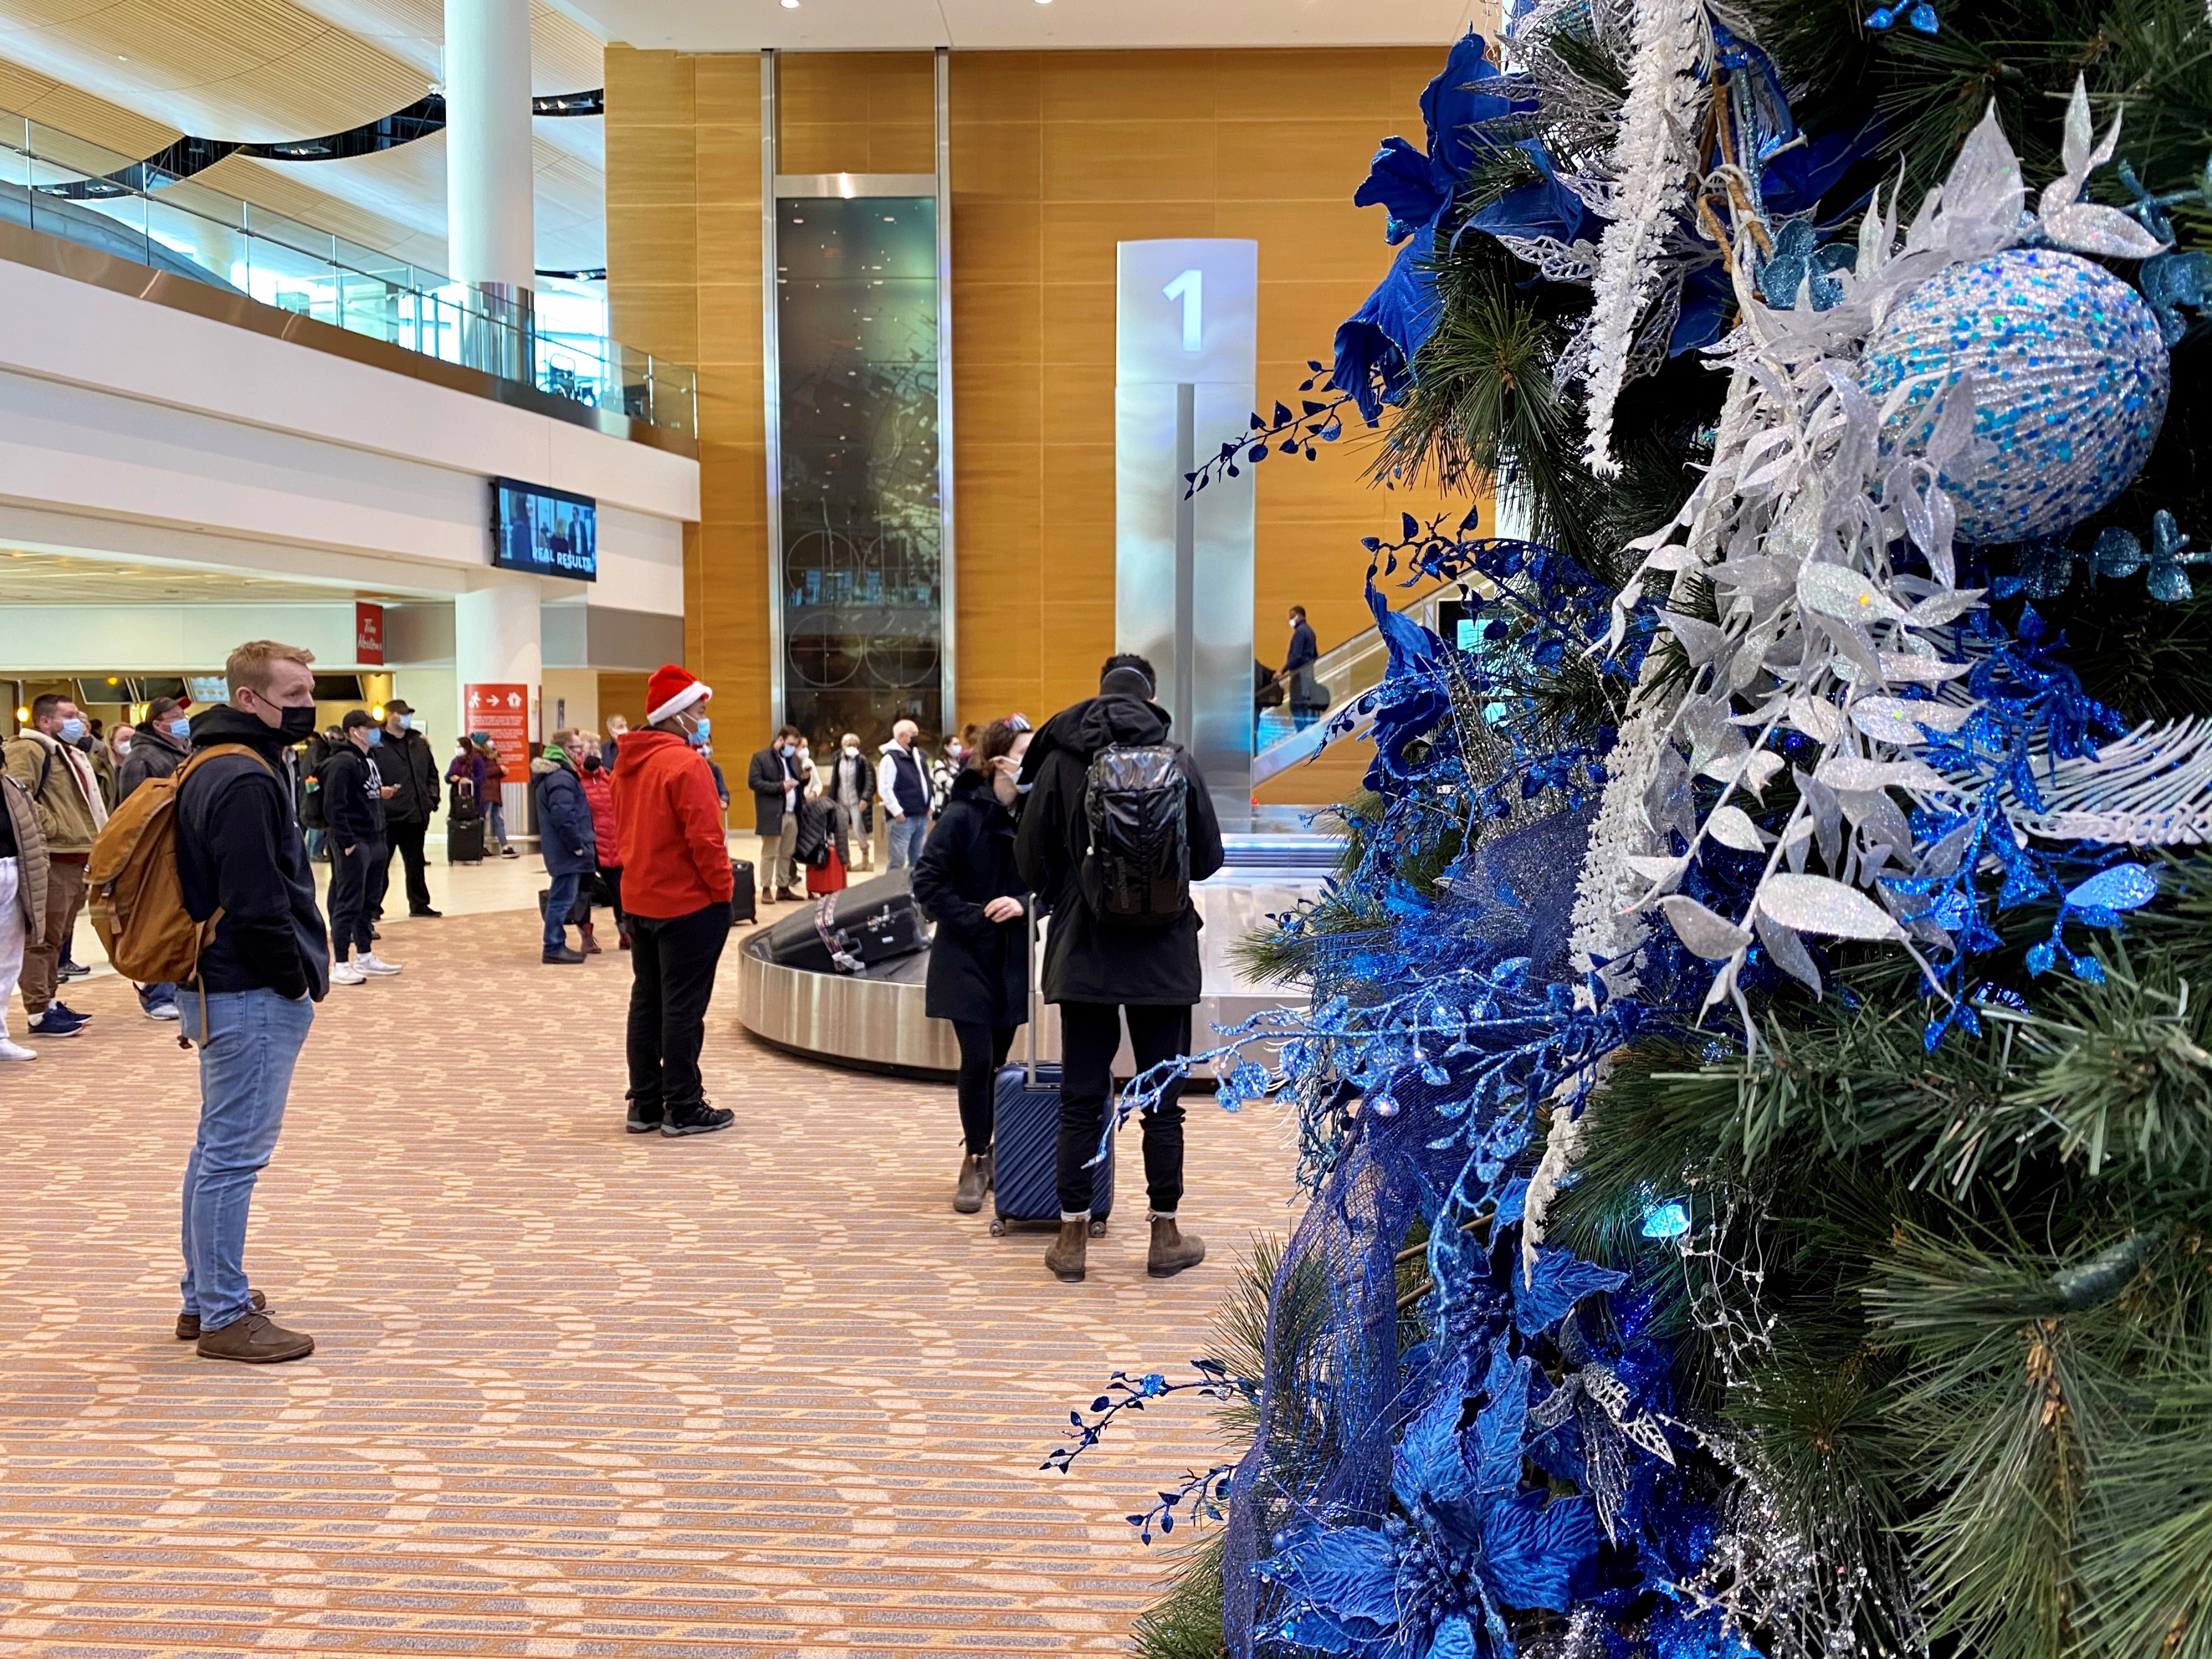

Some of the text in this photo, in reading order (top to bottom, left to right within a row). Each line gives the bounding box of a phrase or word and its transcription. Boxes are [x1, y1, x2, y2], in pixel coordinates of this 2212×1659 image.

[1162, 269, 1202, 351] 1
[532, 546, 591, 569] REAL RESULTS
[364, 618, 377, 634] Tim
